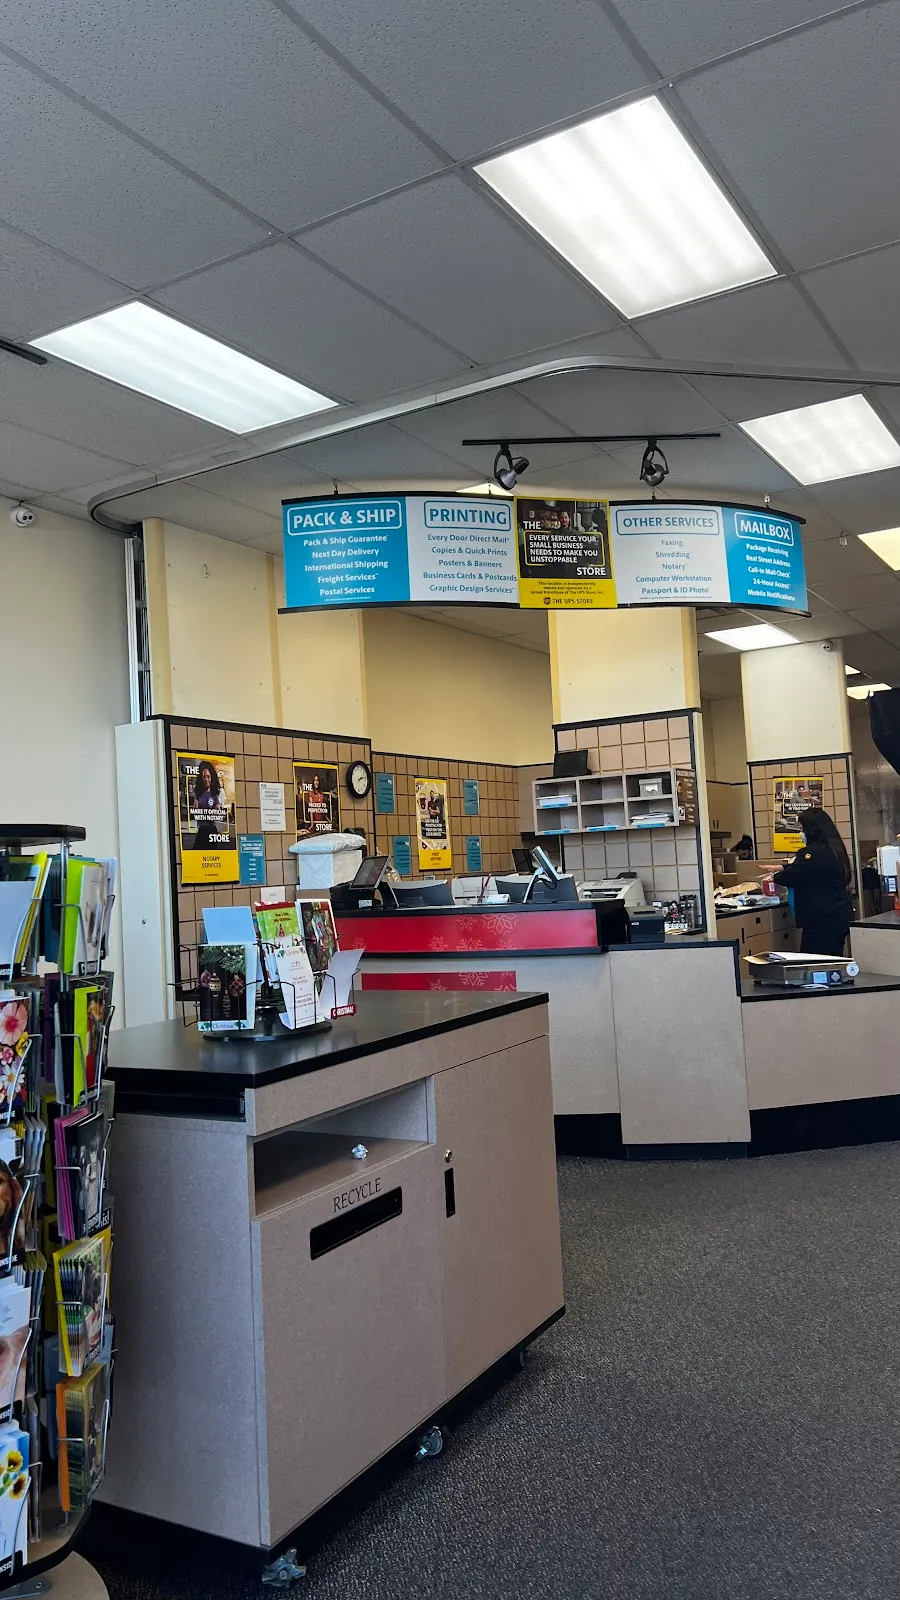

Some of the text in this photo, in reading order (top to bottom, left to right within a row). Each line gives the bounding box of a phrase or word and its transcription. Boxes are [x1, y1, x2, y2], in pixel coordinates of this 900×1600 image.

[294, 509, 396, 528] PACK & SHIP
[429, 509, 506, 524] PRINTING
[523, 521, 541, 529] THE
[623, 517, 714, 527] OTHER SERVICES
[741, 520, 790, 540] MAILBOX
[330, 537, 346, 545] Ship
[746, 543, 788, 557] Package Receiving
[305, 562, 353, 571] International
[773, 559, 790, 567] Address
[577, 567, 606, 576] STORE
[318, 575, 344, 584] Freight
[753, 578, 774, 586] 24-Hour
[320, 587, 342, 596] Postal
[767, 591, 795, 601] Notifications
[185, 766, 199, 774] THE
[209, 834, 230, 842] STORE
[333, 1178, 382, 1212] RECYCLE
